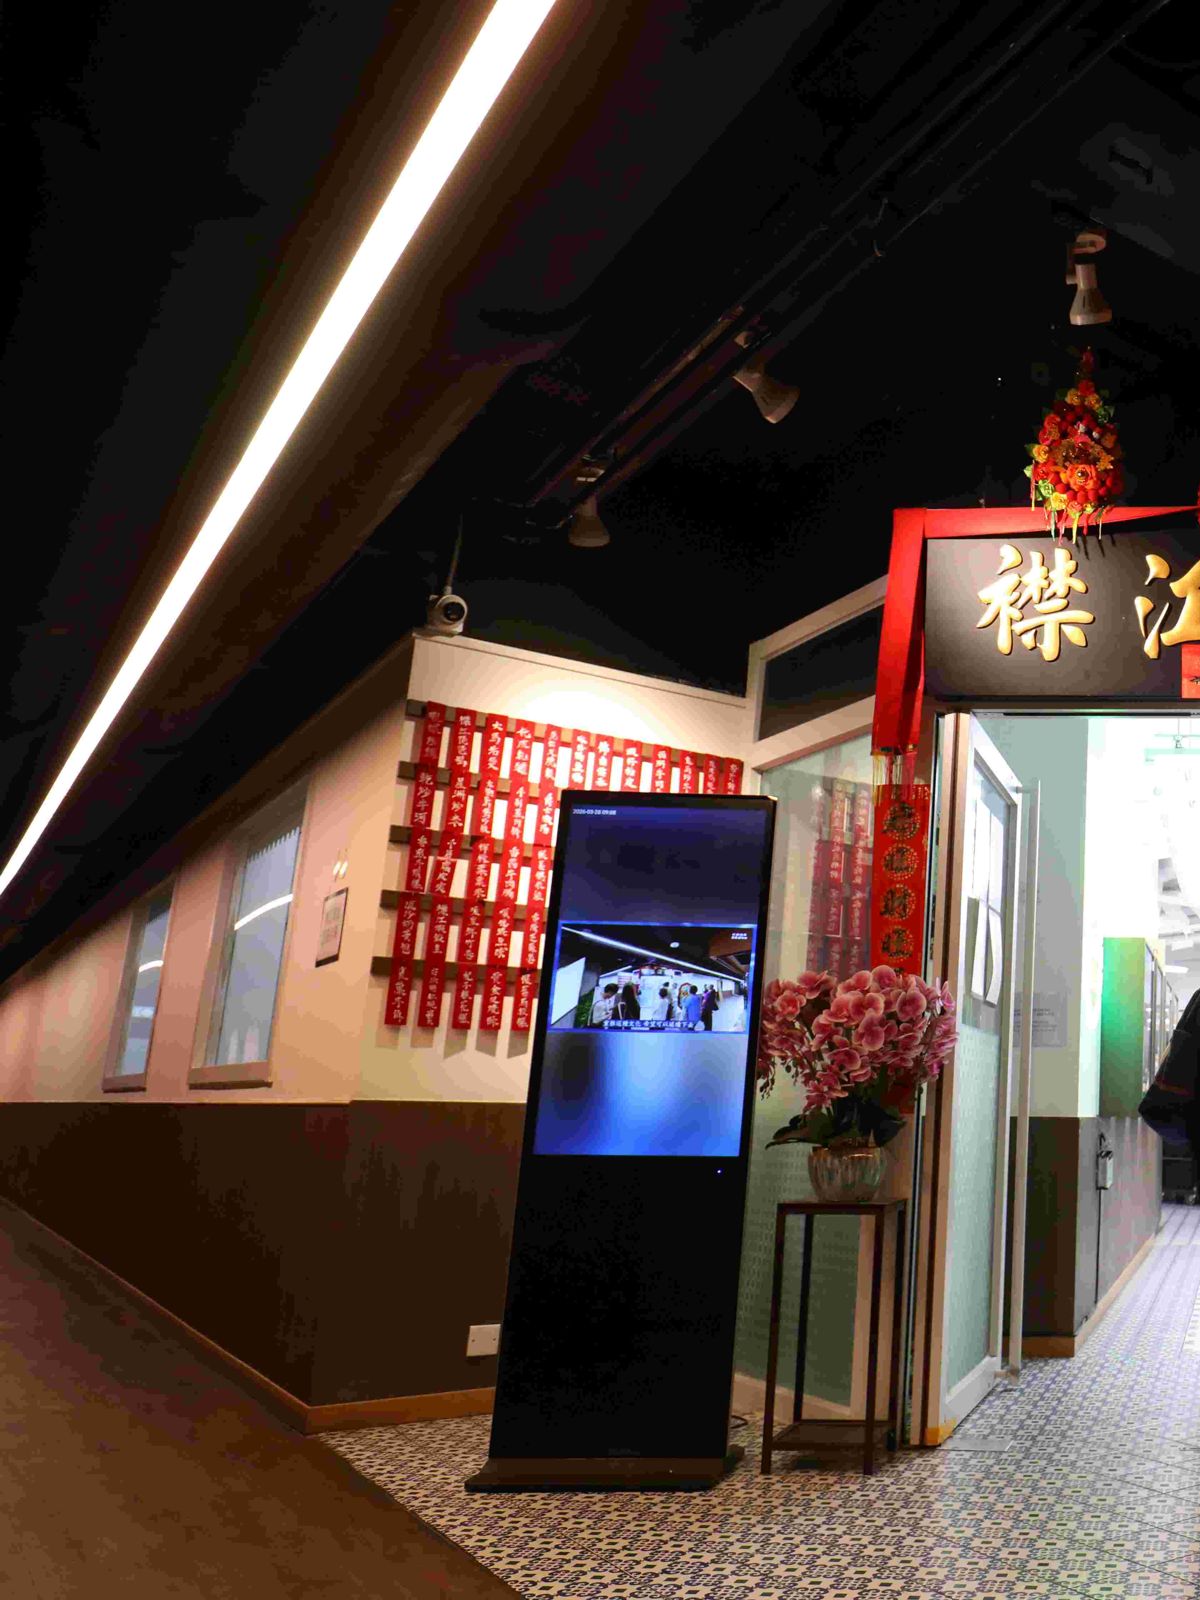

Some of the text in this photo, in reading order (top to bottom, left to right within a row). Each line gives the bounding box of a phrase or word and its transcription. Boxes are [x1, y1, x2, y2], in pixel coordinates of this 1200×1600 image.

[413, 772, 434, 825] 乾炒牛河
[447, 777, 467, 828] 星洲炒米
